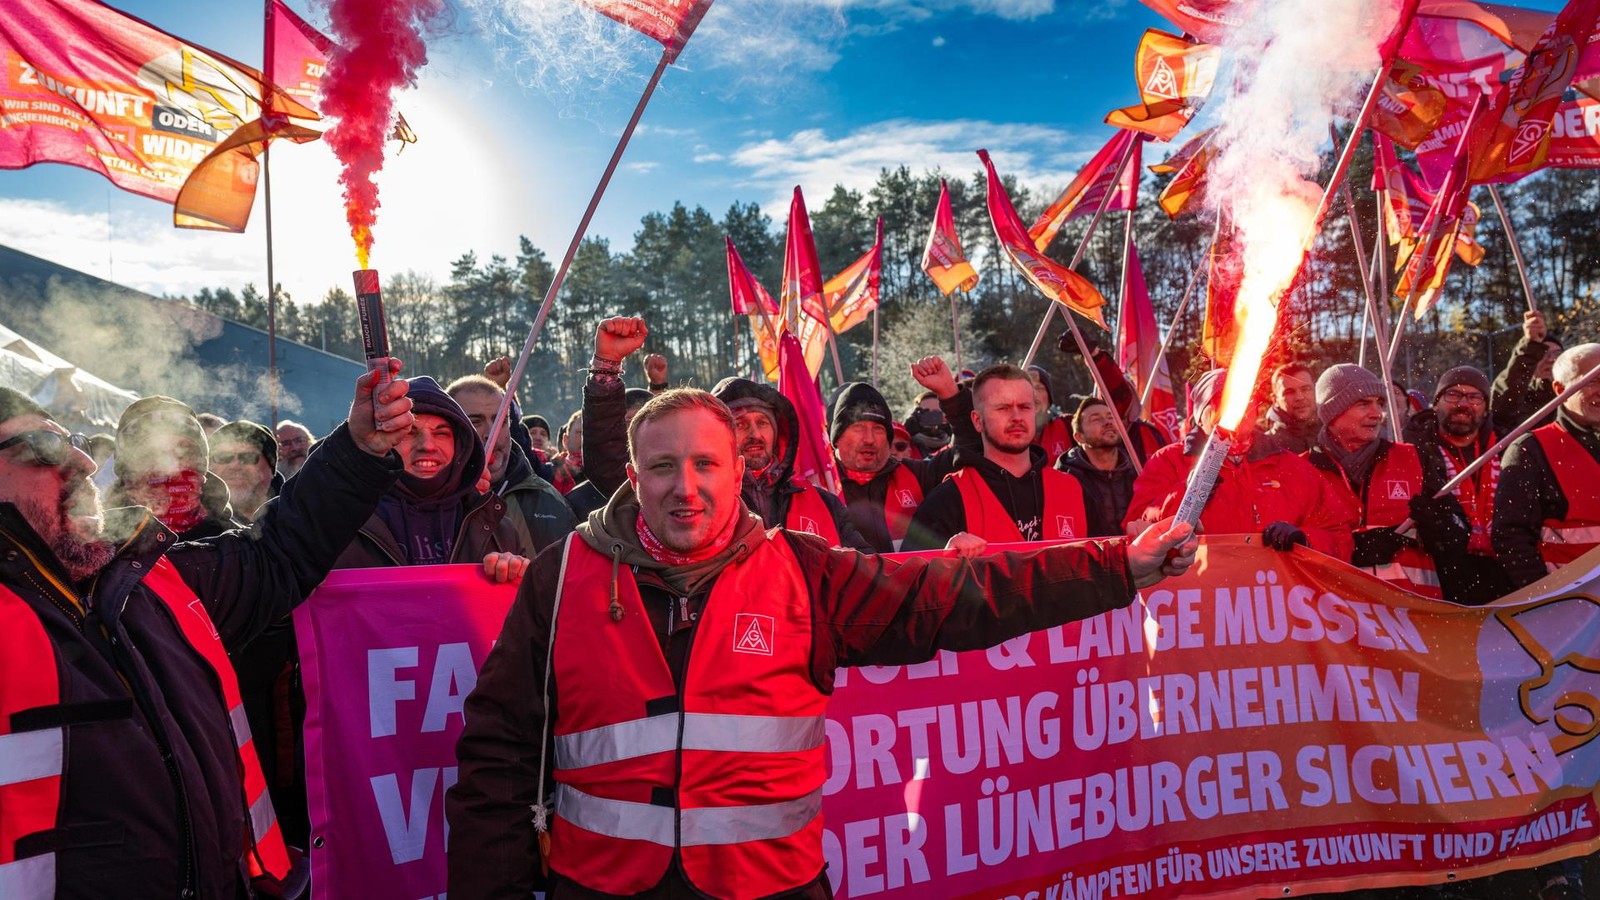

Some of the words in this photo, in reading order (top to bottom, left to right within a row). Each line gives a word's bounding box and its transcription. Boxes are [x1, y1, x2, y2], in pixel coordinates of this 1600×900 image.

[3, 99, 29, 110] WIR
[31, 101, 61, 113] SIND
[18, 61, 150, 118] ZUKUNFT
[306, 62, 326, 78] ZU
[158, 111, 212, 135] ODER
[1047, 588, 1204, 665] LANGE
[1215, 569, 1429, 654] MÜSSEN
[367, 641, 481, 739] FA
[1072, 663, 1420, 751] ÜBERNEHMEN
[944, 750, 1289, 877] LÜNEBURGER
[1295, 731, 1564, 807] SICHERN
[1155, 846, 1203, 888] FÜR
[1207, 840, 1300, 880] UNSERE
[1303, 832, 1426, 867] ZUKUNFT
[1433, 832, 1494, 859] UND
[1500, 802, 1593, 853] FAMILIE
